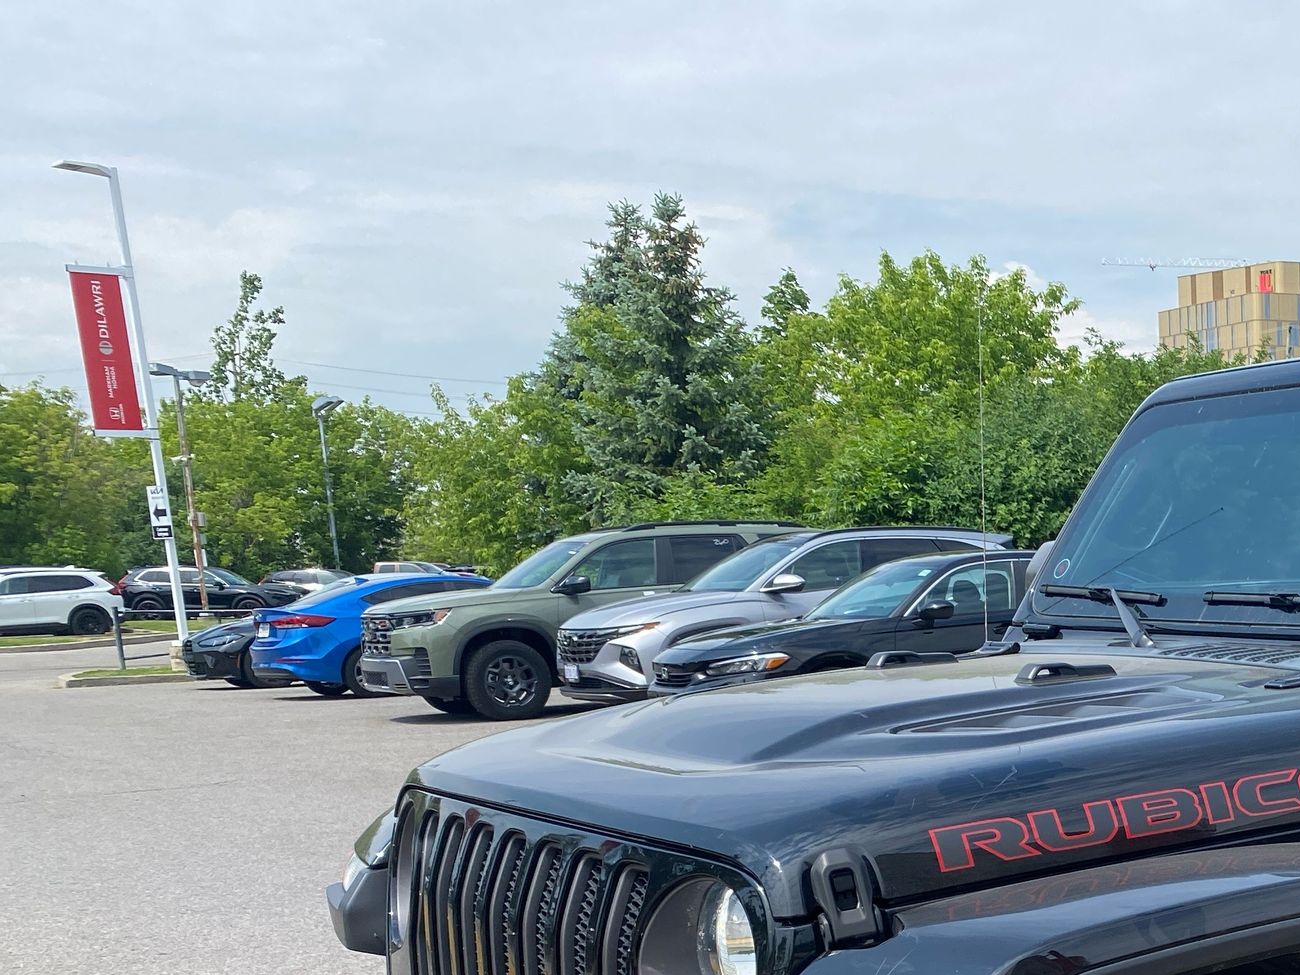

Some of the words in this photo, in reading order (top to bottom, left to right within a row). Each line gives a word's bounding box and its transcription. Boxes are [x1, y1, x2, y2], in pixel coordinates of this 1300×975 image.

[90, 280, 109, 338] DILAWRI
[104, 366, 114, 398] MARKHAM
[110, 366, 118, 389] HONDA
